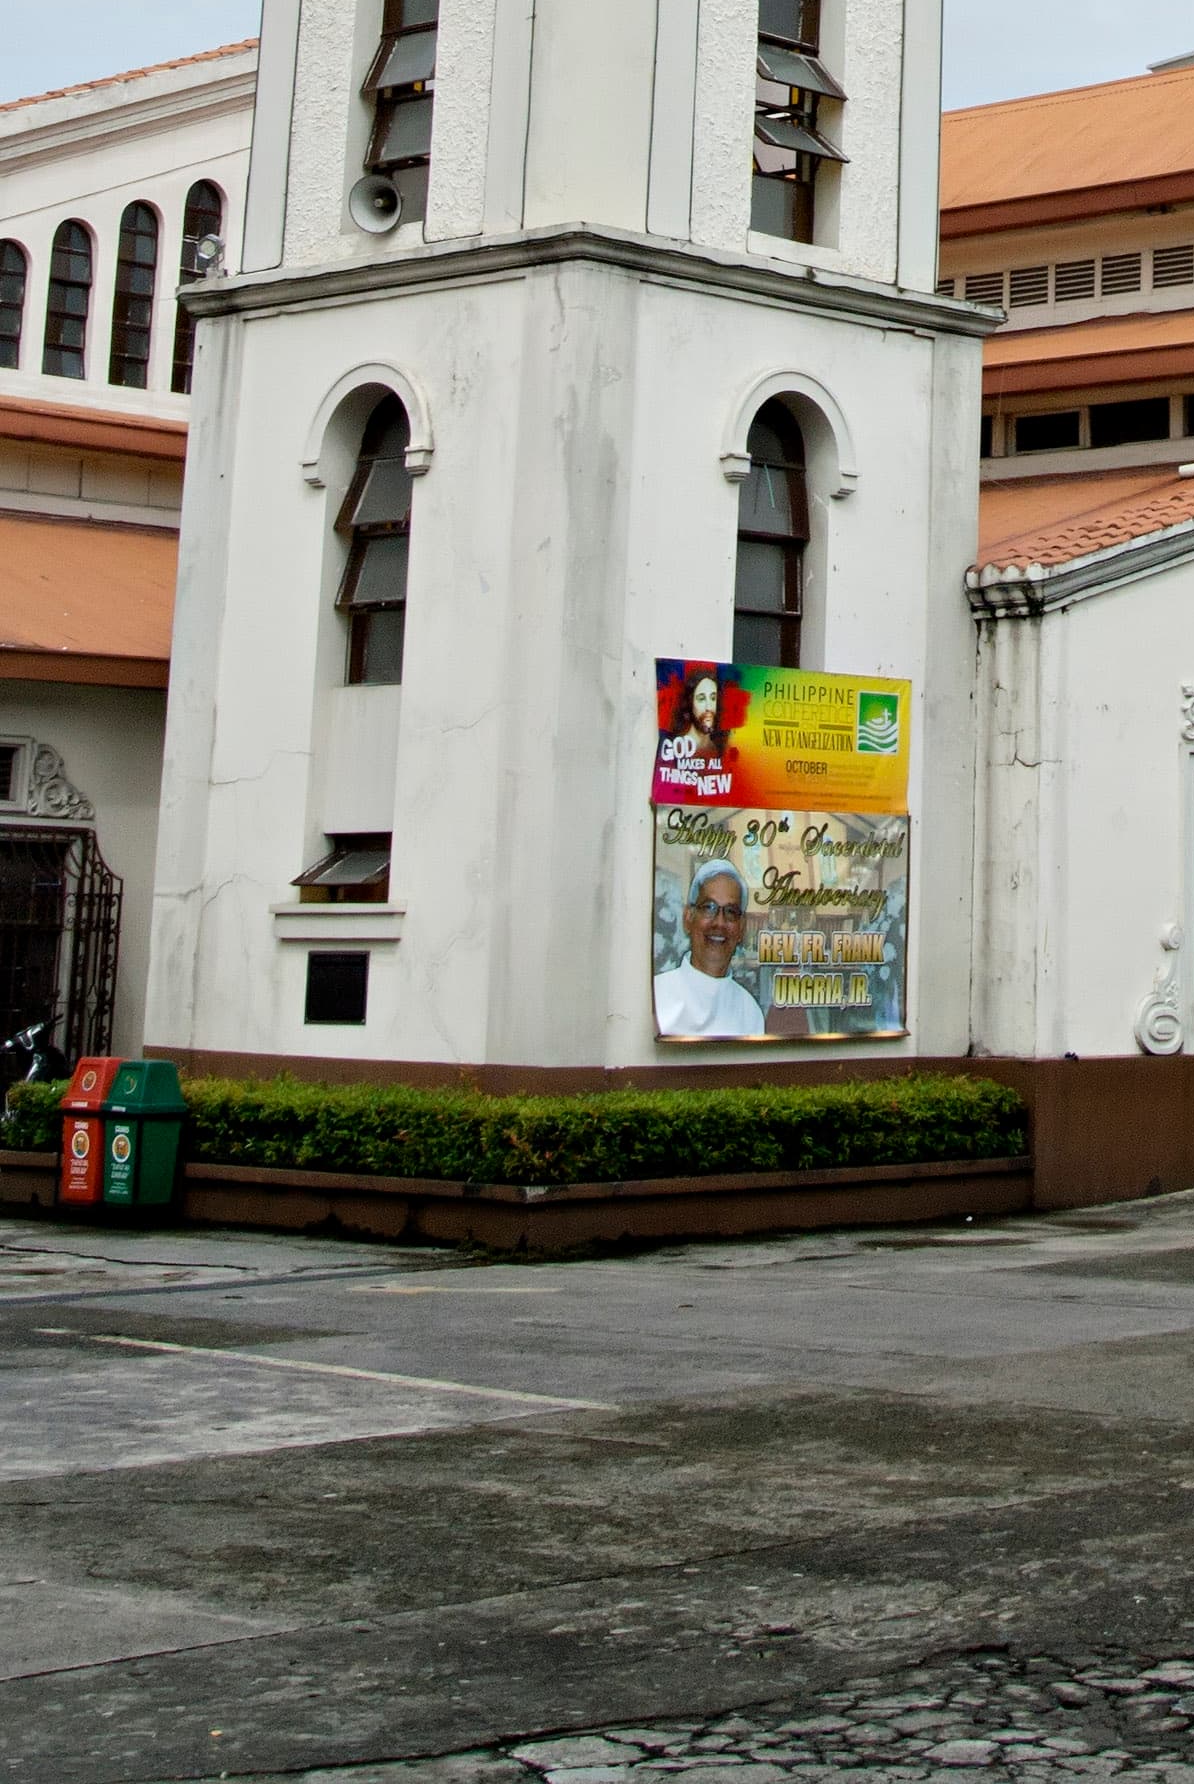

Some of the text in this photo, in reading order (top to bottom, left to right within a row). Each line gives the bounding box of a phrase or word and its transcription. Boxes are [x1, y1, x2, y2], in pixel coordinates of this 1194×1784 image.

[764, 681, 855, 706] PHILIPPINE
[661, 735, 697, 761] GOD
[763, 727, 853, 753] NEW EVANGELIZATION
[677, 758, 722, 770] MAKES ALL
[786, 759, 829, 776] OCTOBER
[660, 767, 732, 796] THINGS NEW
[663, 808, 737, 858] Happy
[800, 822, 905, 859] Sacerdotal
[754, 866, 888, 921] Anniversary
[758, 930, 888, 966] REV. FR. FRANK
[774, 972, 873, 1010] UNGRIA, JR.
